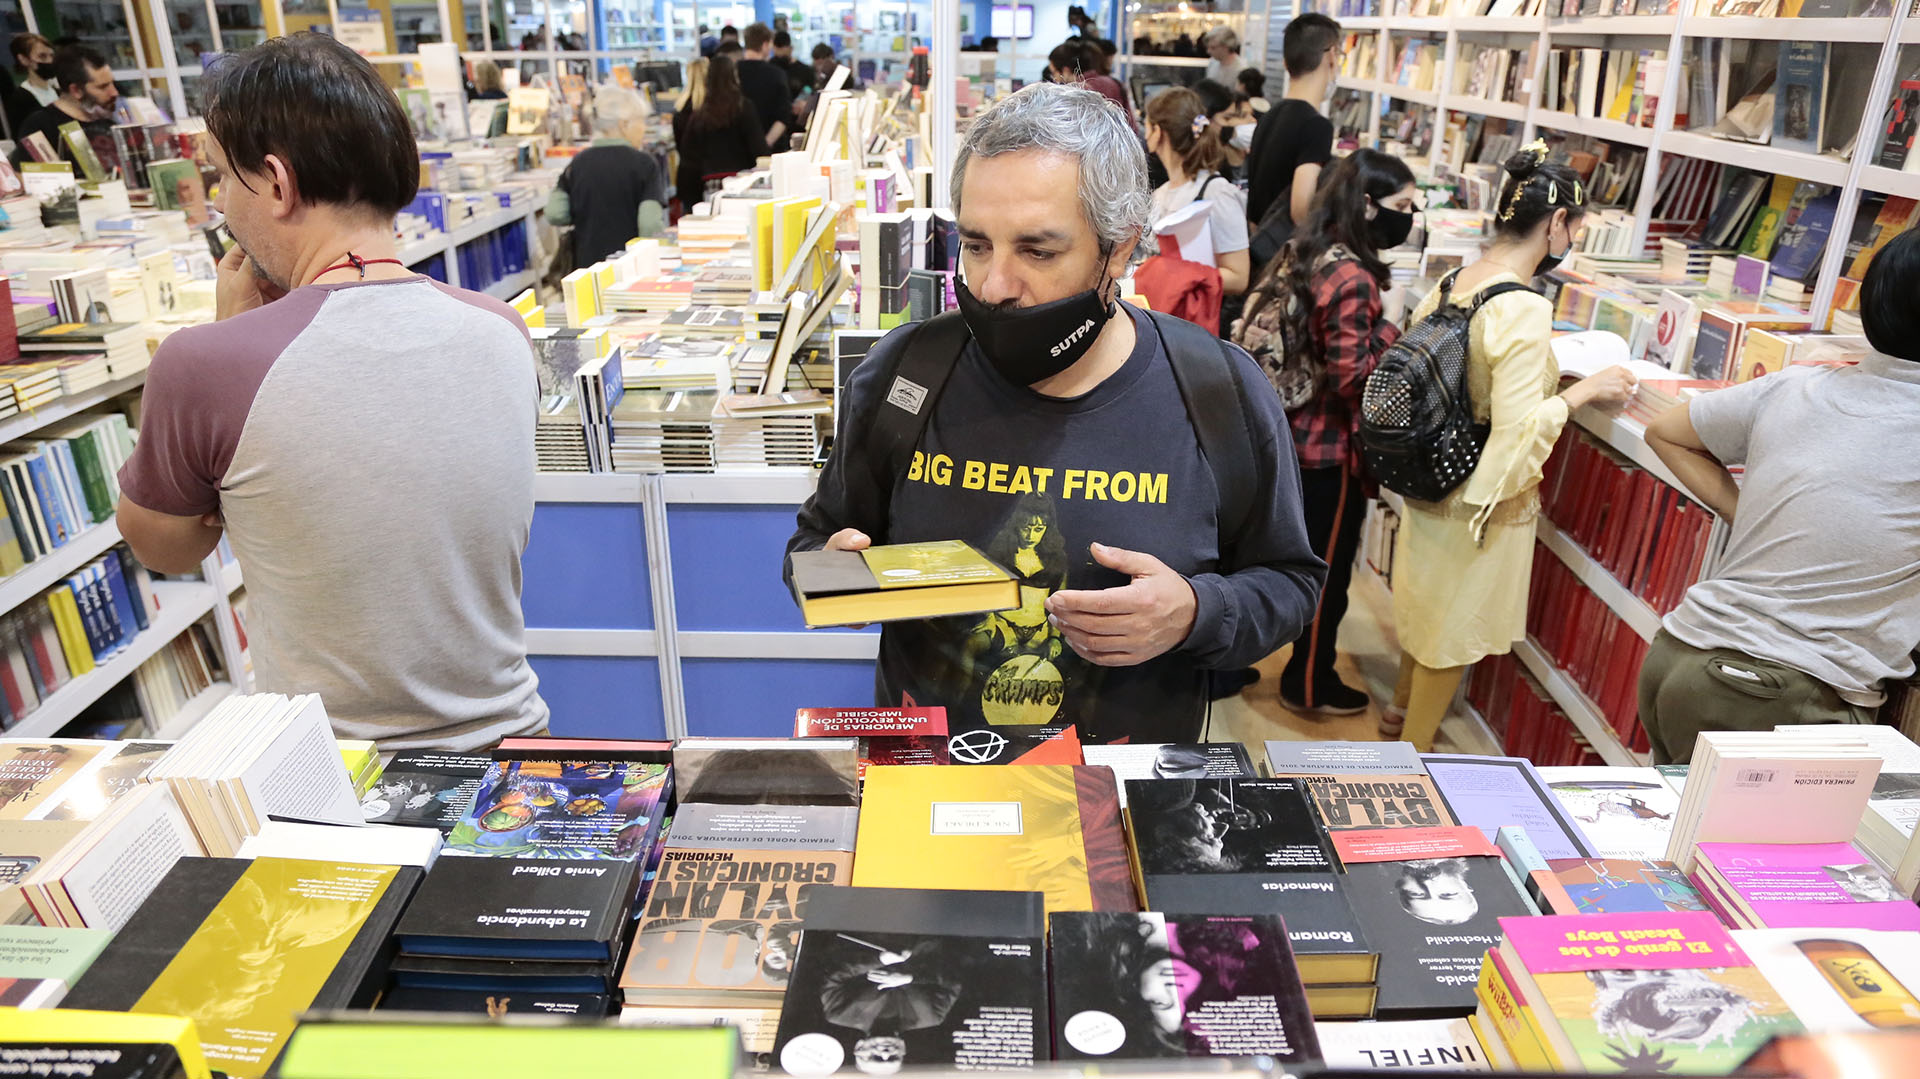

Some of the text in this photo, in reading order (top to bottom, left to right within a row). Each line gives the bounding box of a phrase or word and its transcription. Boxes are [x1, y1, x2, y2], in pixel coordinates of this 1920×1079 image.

[1050, 319, 1096, 357] SUTPA
[908, 451, 1169, 504] BIG BEAT FROM
[983, 677, 1064, 706] CRAMPS
[811, 716, 927, 726] UNA REVOLUCIÓN
[836, 711, 902, 719] IMPOSIBLE
[823, 722, 915, 731] MEMORIAS DE
[1309, 782, 1427, 798] CRÓNICA
[1317, 798, 1441, 825] DYLA
[665, 852, 733, 861] MEMORIAS
[512, 866, 607, 877] Annie Dillard
[1261, 882, 1334, 892] Memorias
[553, 908, 591, 916] Ensayos
[477, 915, 587, 928] La abundancia
[1288, 931, 1354, 943] Roman
[1425, 935, 1491, 944] Hochschild
[1565, 928, 1684, 943] Beach Boys
[1558, 940, 1712, 958] El genio de los
[1359, 1045, 1477, 1067] INFIEL
